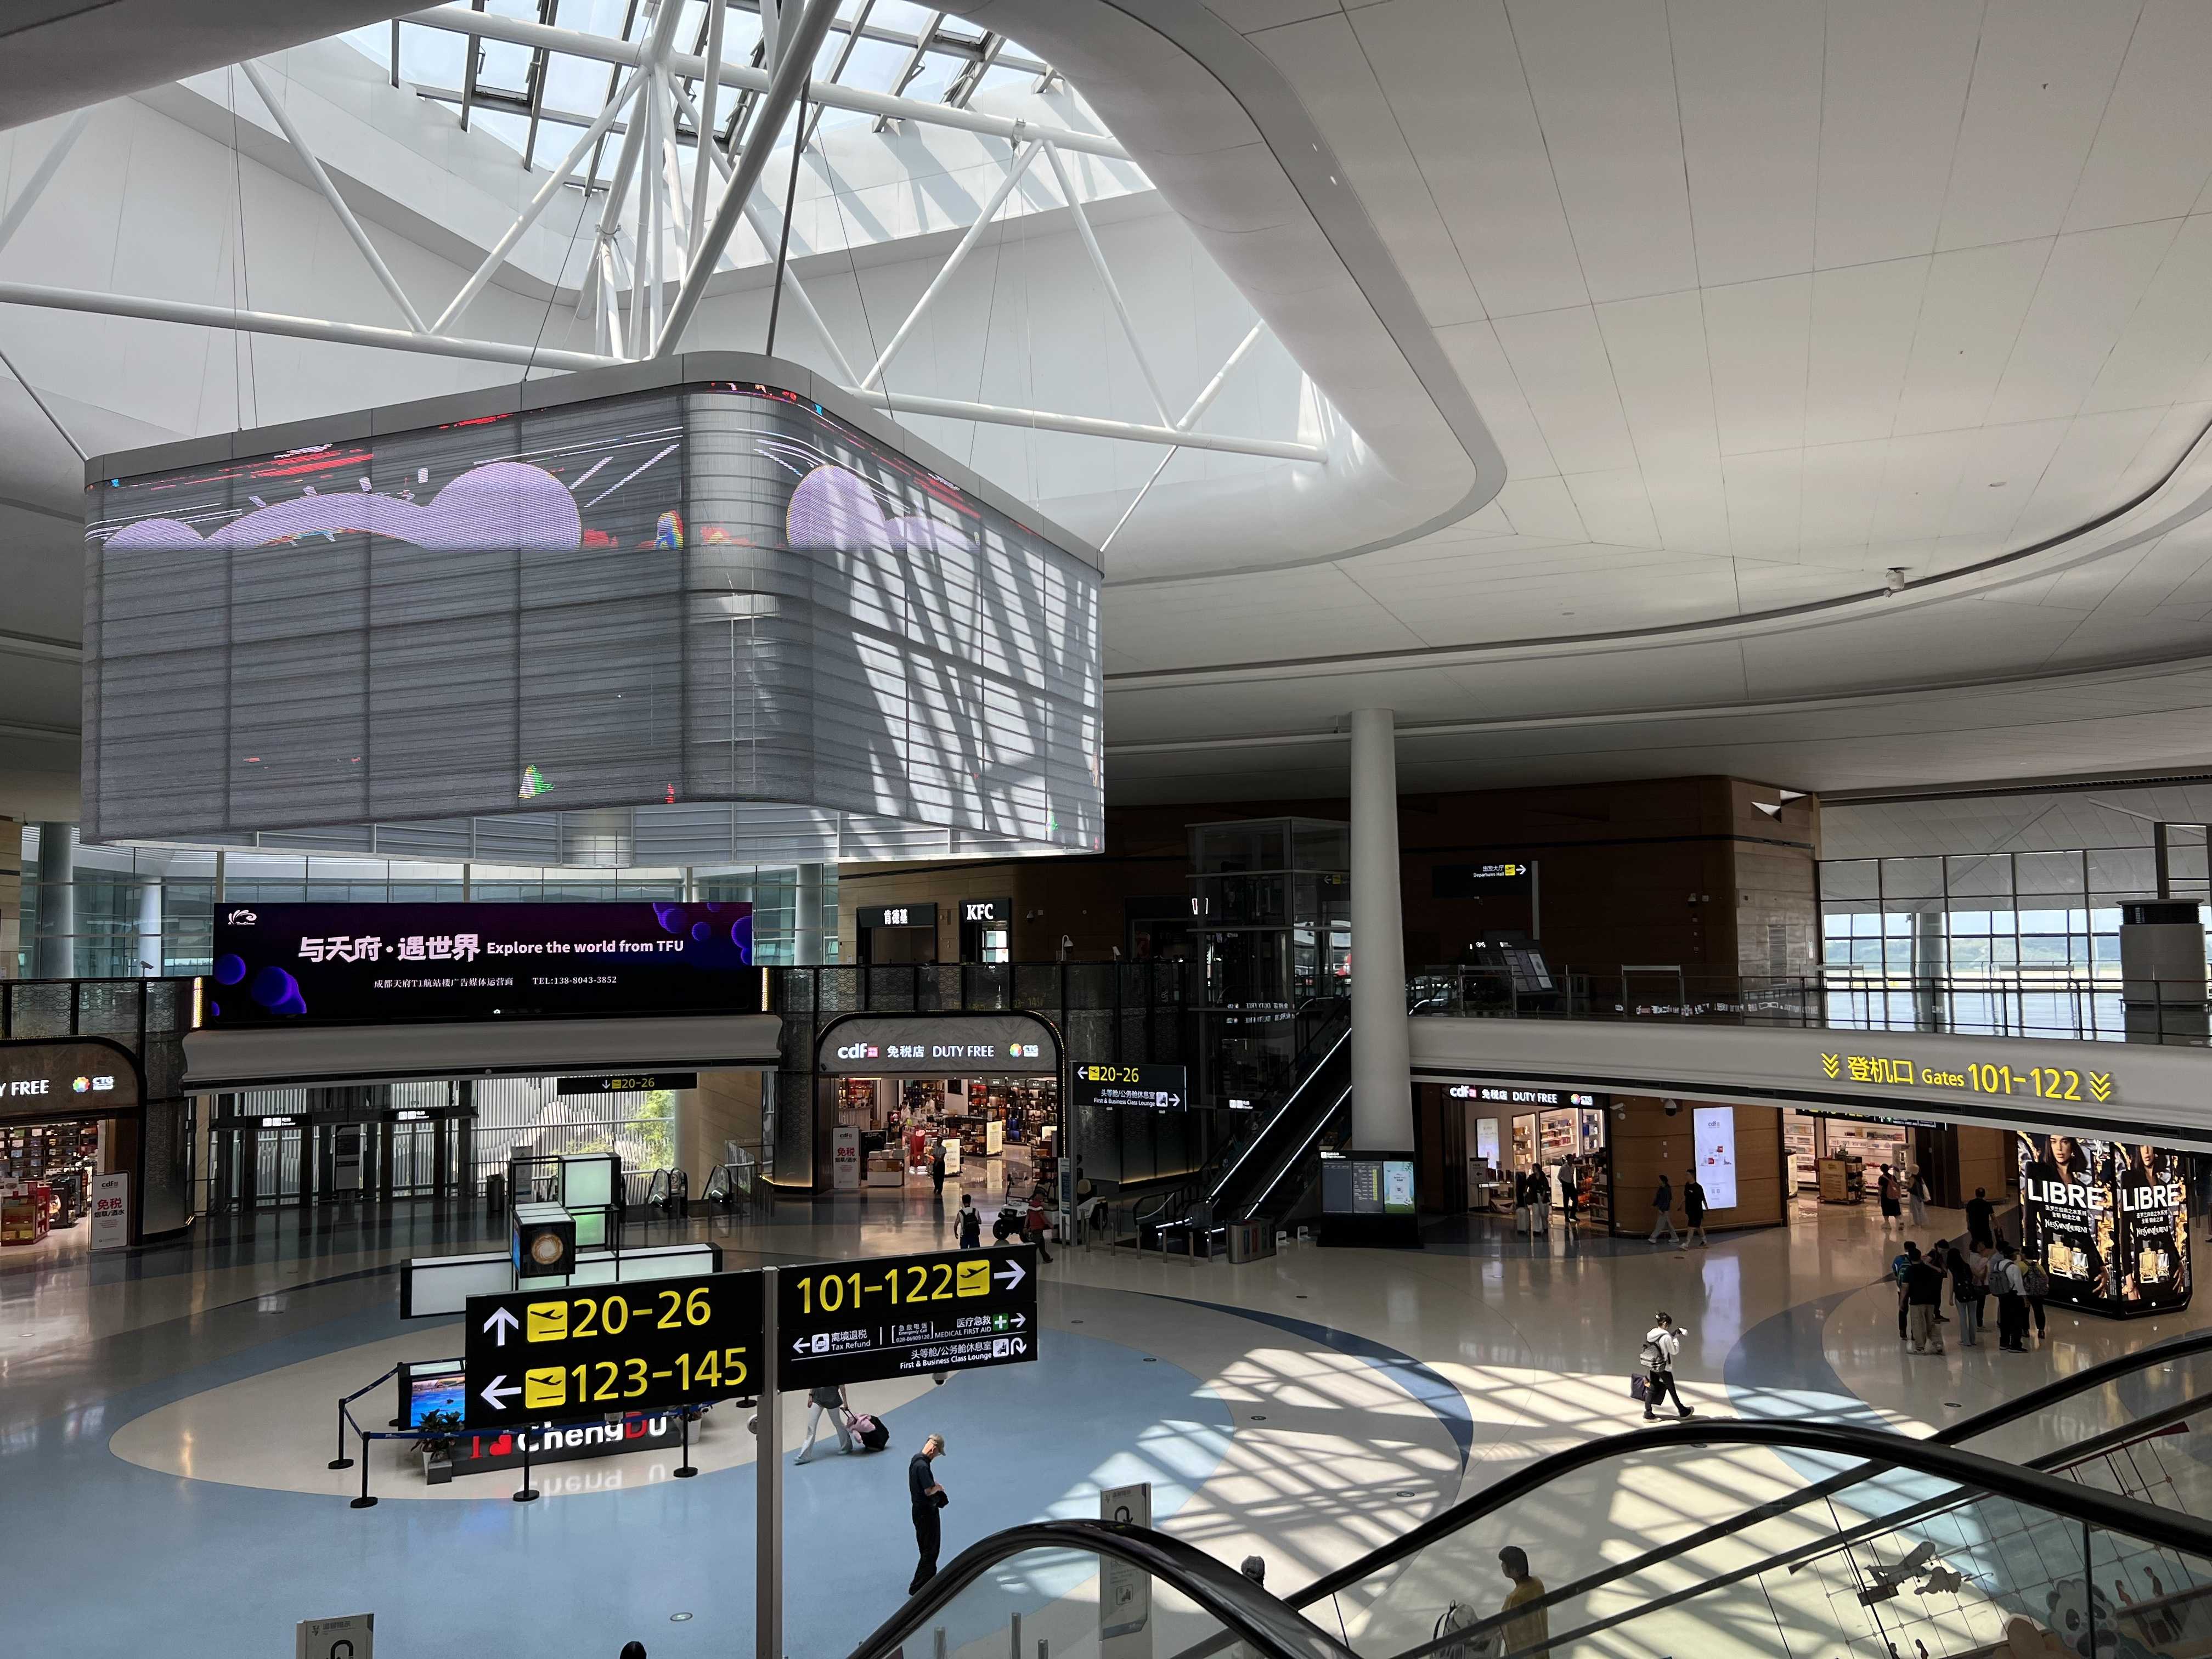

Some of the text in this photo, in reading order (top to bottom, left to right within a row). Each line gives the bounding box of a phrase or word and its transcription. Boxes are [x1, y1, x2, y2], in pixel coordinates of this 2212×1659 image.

[884, 909, 907, 924] 肯德基
[967, 904, 993, 920] KFC
[298, 934, 481, 962] 与天府·遇世界
[488, 940, 683, 956] Explore the world from TFU
[838, 1043, 867, 1059] cdf
[887, 1045, 924, 1058] 免税店
[933, 1046, 964, 1057] DUTY
[968, 1046, 994, 1057] FREE
[1101, 1066, 1139, 1082] 20-26
[1848, 1057, 2081, 1100] 登机口 Gates 101-122
[12, 1080, 49, 1096] FREE
[621, 1077, 654, 1088] 20-26
[1450, 1085, 1469, 1097] cdf
[1482, 1089, 1507, 1100] 免税店
[1513, 1092, 1535, 1102] DUTY
[1537, 1093, 1558, 1103] FREE
[2028, 1178, 2103, 1211] LIBRE
[2123, 1184, 2180, 1211] LIBRE
[97, 1198, 122, 1210] 免税
[797, 1264, 952, 1313] 101-122
[573, 1288, 710, 1338] 20-26
[957, 1316, 991, 1328] 医疗急救
[831, 1329, 867, 1342] 离境退税
[935, 1330, 962, 1338] MEDICAL
[832, 1340, 871, 1350] Tax Refund
[911, 1341, 991, 1358] 头等舱/公务舱休息室
[922, 1357, 949, 1366] Business
[968, 1351, 991, 1361] Lounge
[572, 1347, 746, 1402] 123-145
